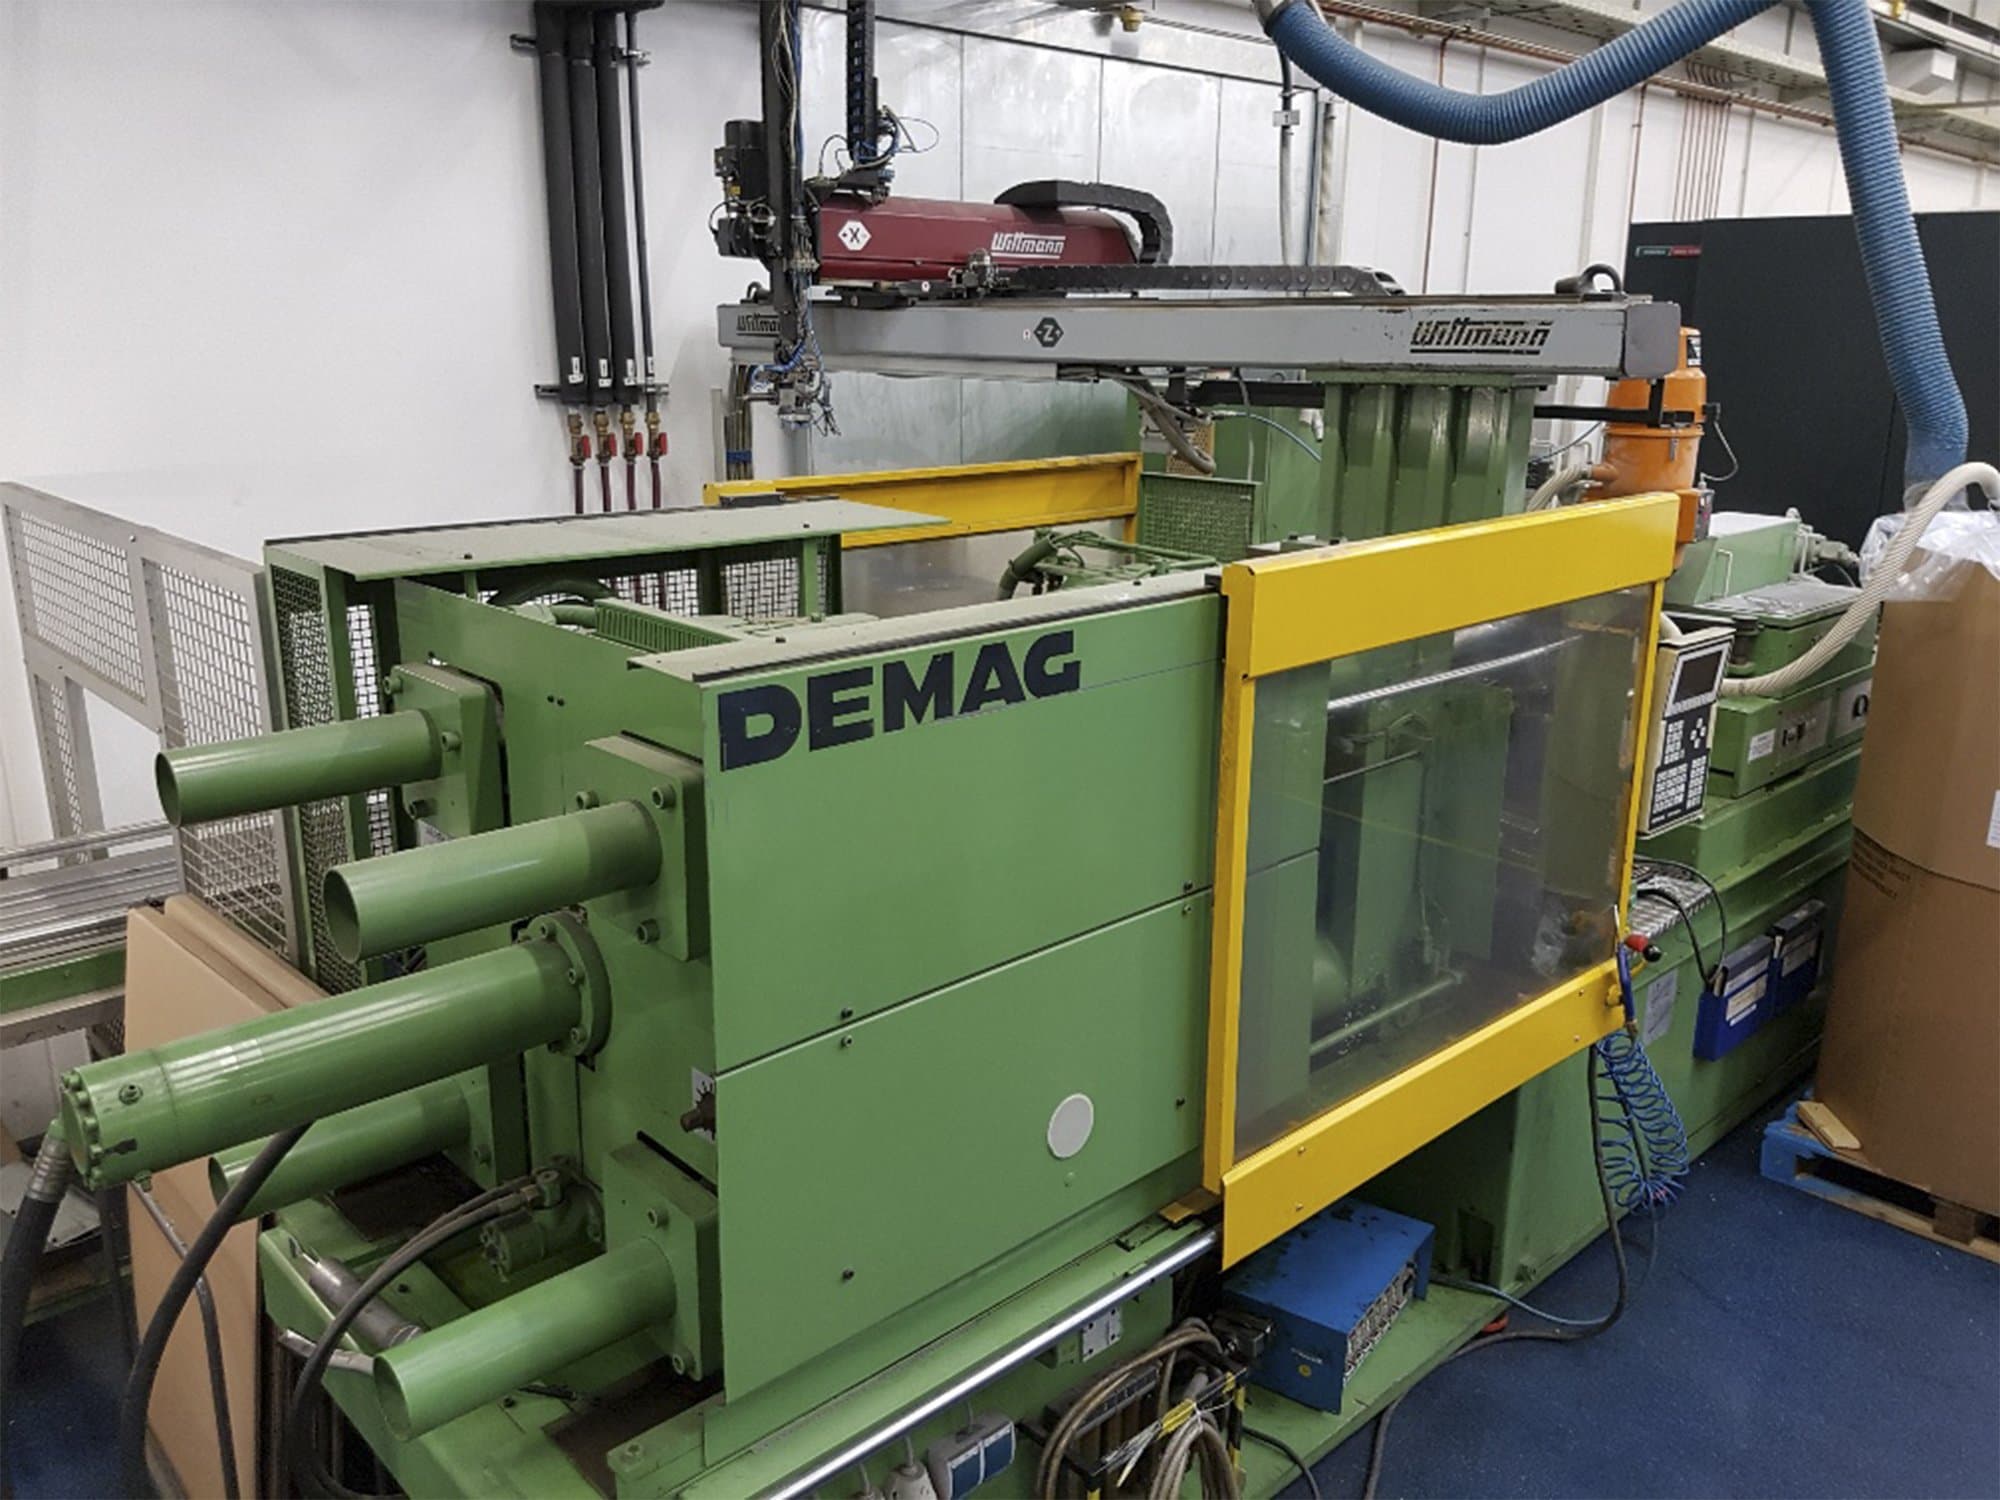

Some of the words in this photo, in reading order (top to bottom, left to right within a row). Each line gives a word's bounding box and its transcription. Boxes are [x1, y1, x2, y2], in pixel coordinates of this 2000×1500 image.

[848, 227, 860, 243] X
[991, 231, 1066, 258] Wittmann
[1042, 324, 1054, 341] Z
[1409, 317, 1553, 354] Wittmann
[717, 629, 1081, 772] DEMAG
